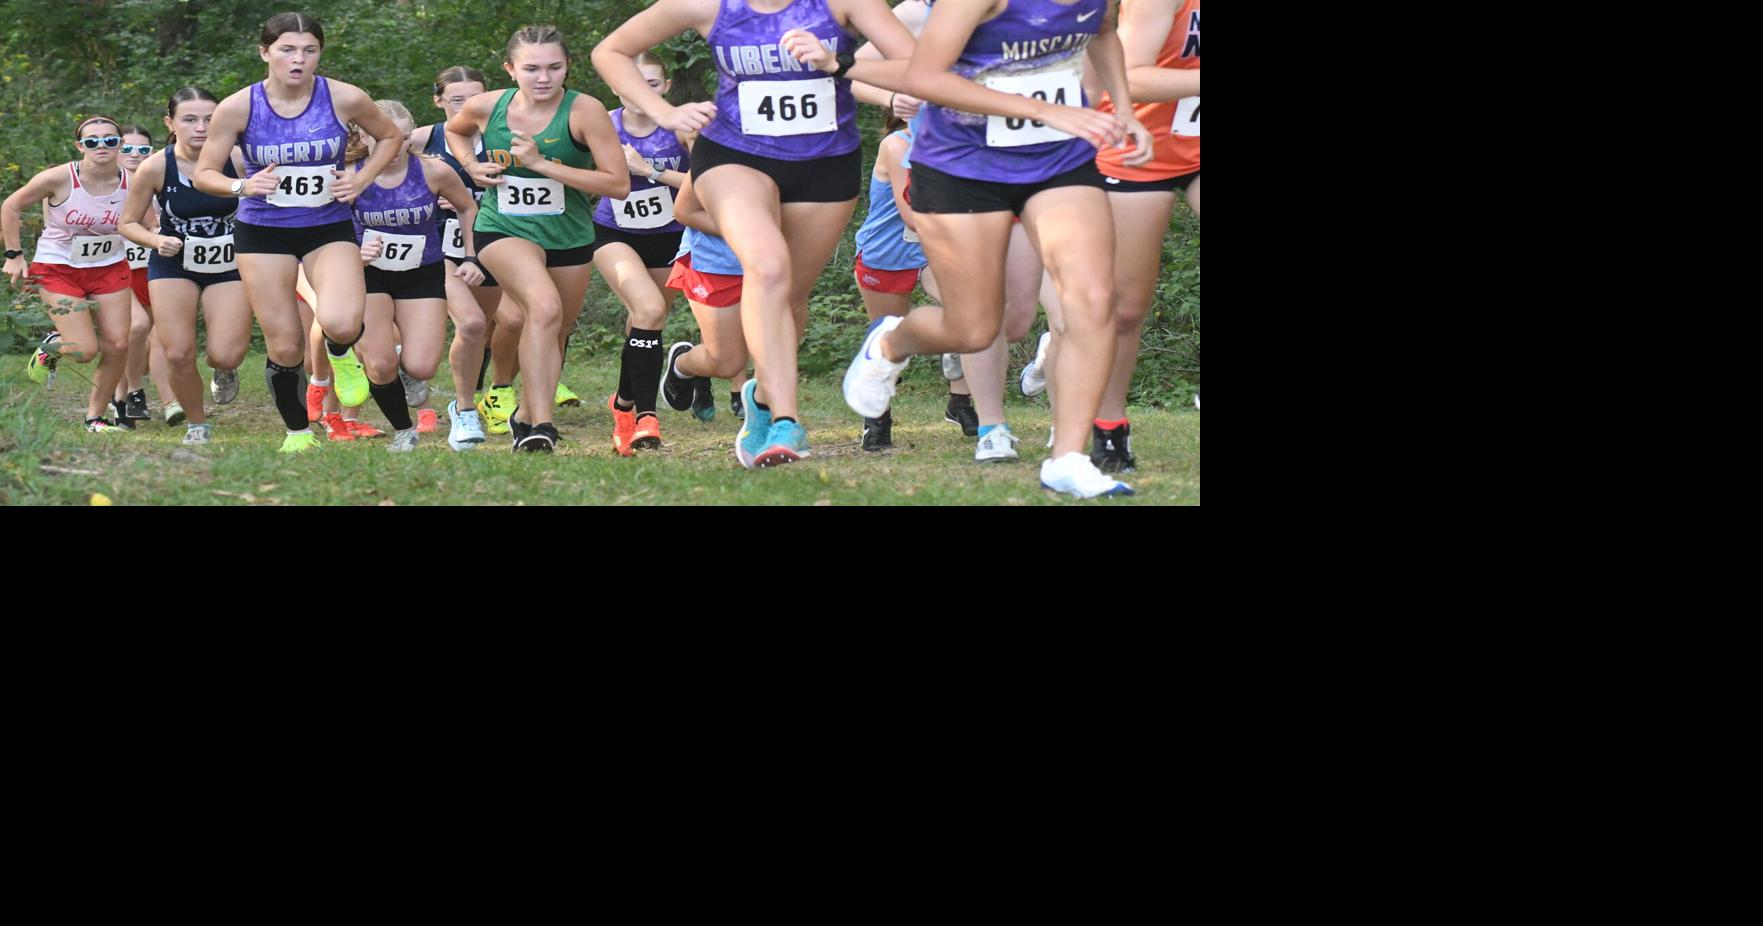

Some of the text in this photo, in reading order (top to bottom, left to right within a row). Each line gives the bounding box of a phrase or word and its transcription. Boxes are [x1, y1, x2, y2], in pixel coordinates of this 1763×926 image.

[715, 37, 838, 76] LIBERY
[758, 94, 817, 121] 466
[246, 136, 340, 166] LIBERTY
[280, 176, 324, 195] 463
[508, 186, 551, 205] 362
[353, 203, 433, 227] LIBERTY
[624, 196, 662, 218] 465
[65, 209, 120, 230] City Hi
[81, 241, 112, 256] 170
[126, 247, 146, 261] 62
[194, 243, 234, 264] 820
[385, 243, 413, 260] 67
